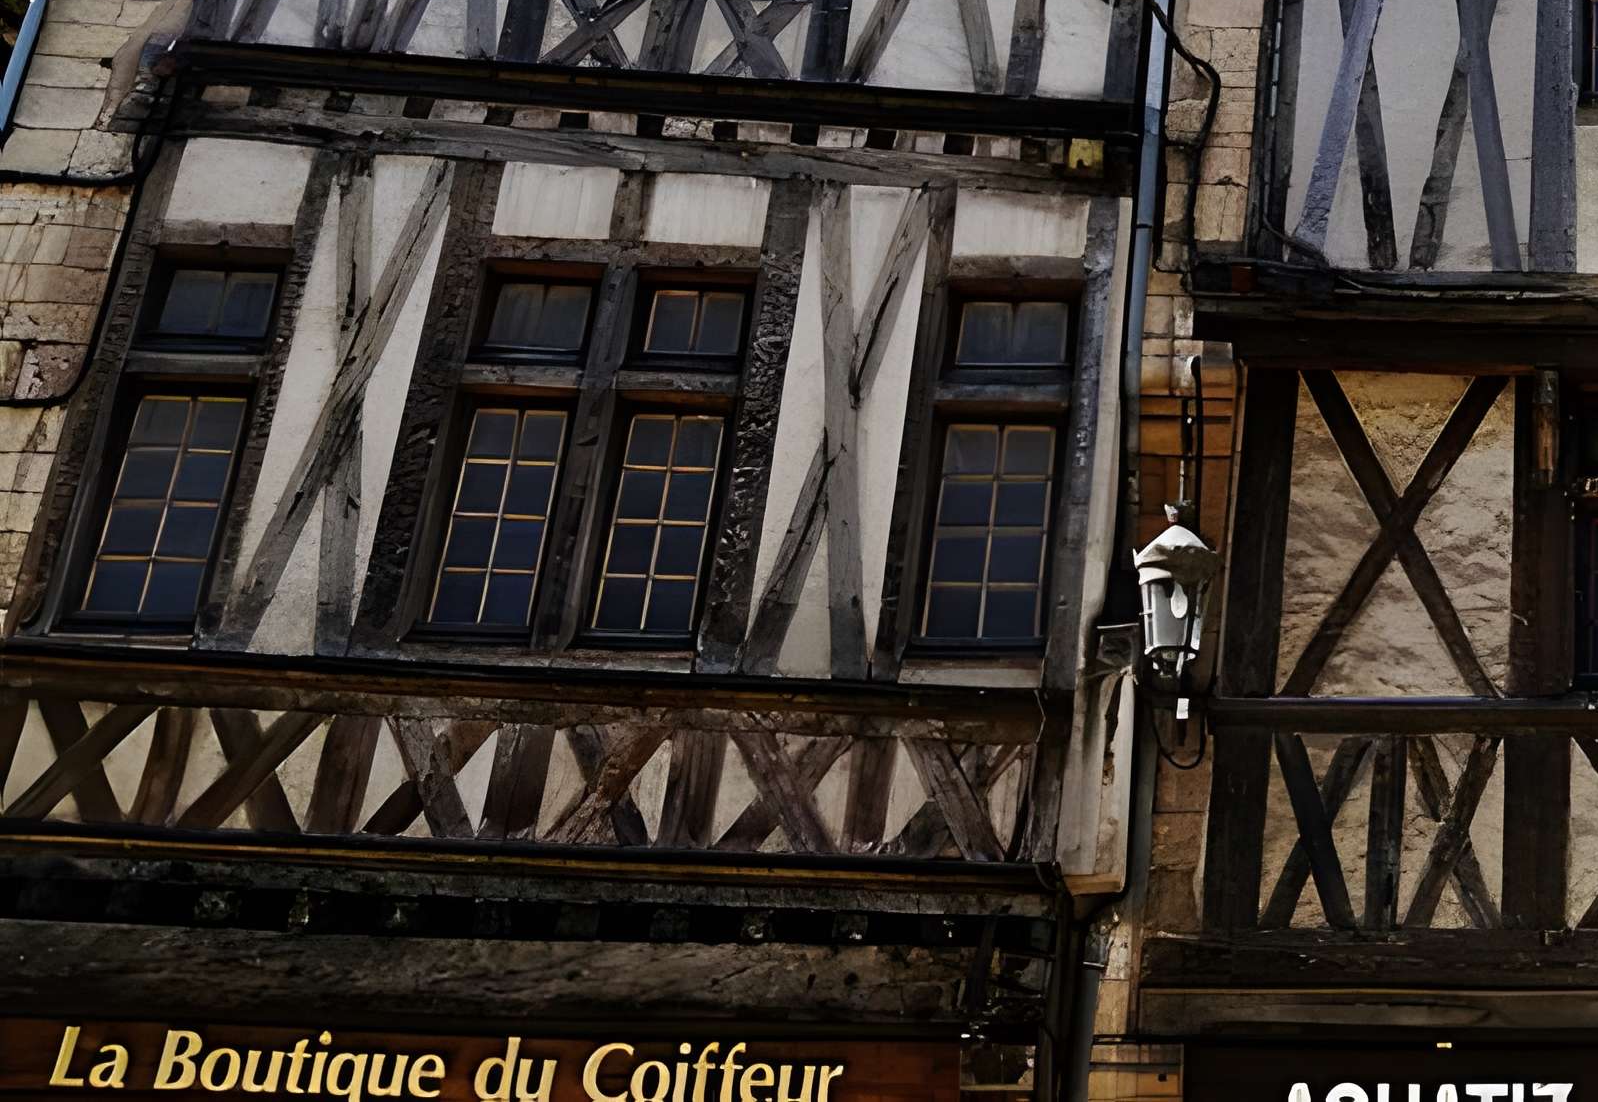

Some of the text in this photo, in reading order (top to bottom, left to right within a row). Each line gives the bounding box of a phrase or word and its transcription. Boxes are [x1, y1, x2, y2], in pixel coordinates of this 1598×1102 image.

[48, 1025, 844, 1102] La Boutique du Coiffeur
